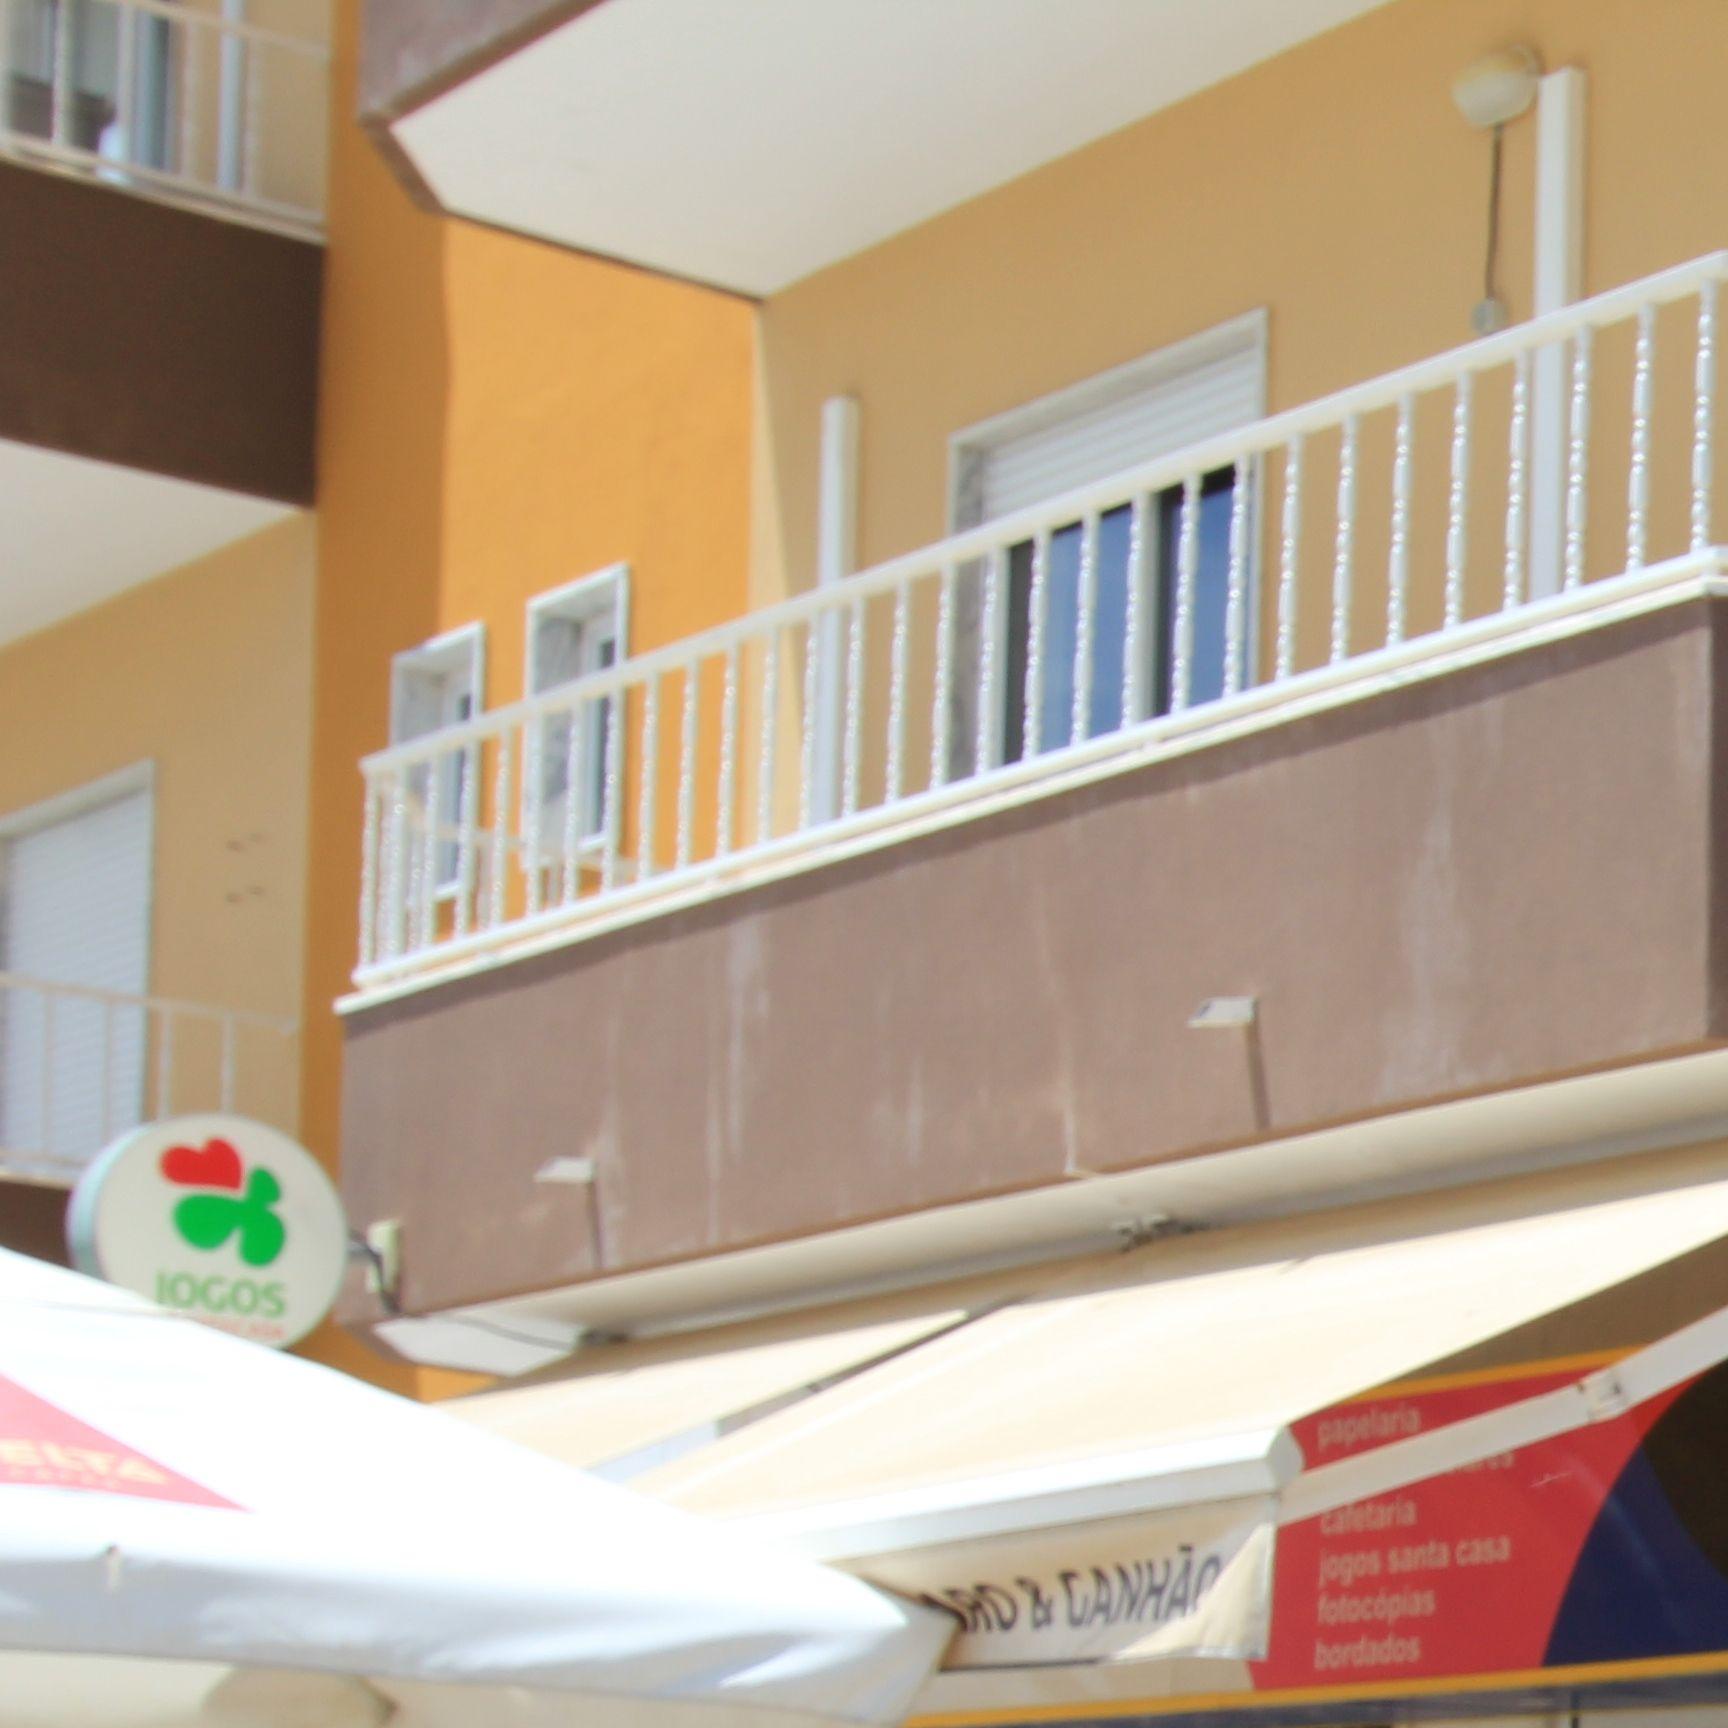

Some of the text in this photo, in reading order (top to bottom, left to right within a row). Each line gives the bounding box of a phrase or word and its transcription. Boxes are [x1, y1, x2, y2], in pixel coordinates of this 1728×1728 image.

[1317, 1405, 1421, 1451] papelaria
[0, 1437, 168, 1485] ELTA
[1317, 1535, 1511, 1588] jogos santa casa
[1313, 1631, 1421, 1672] bordados
